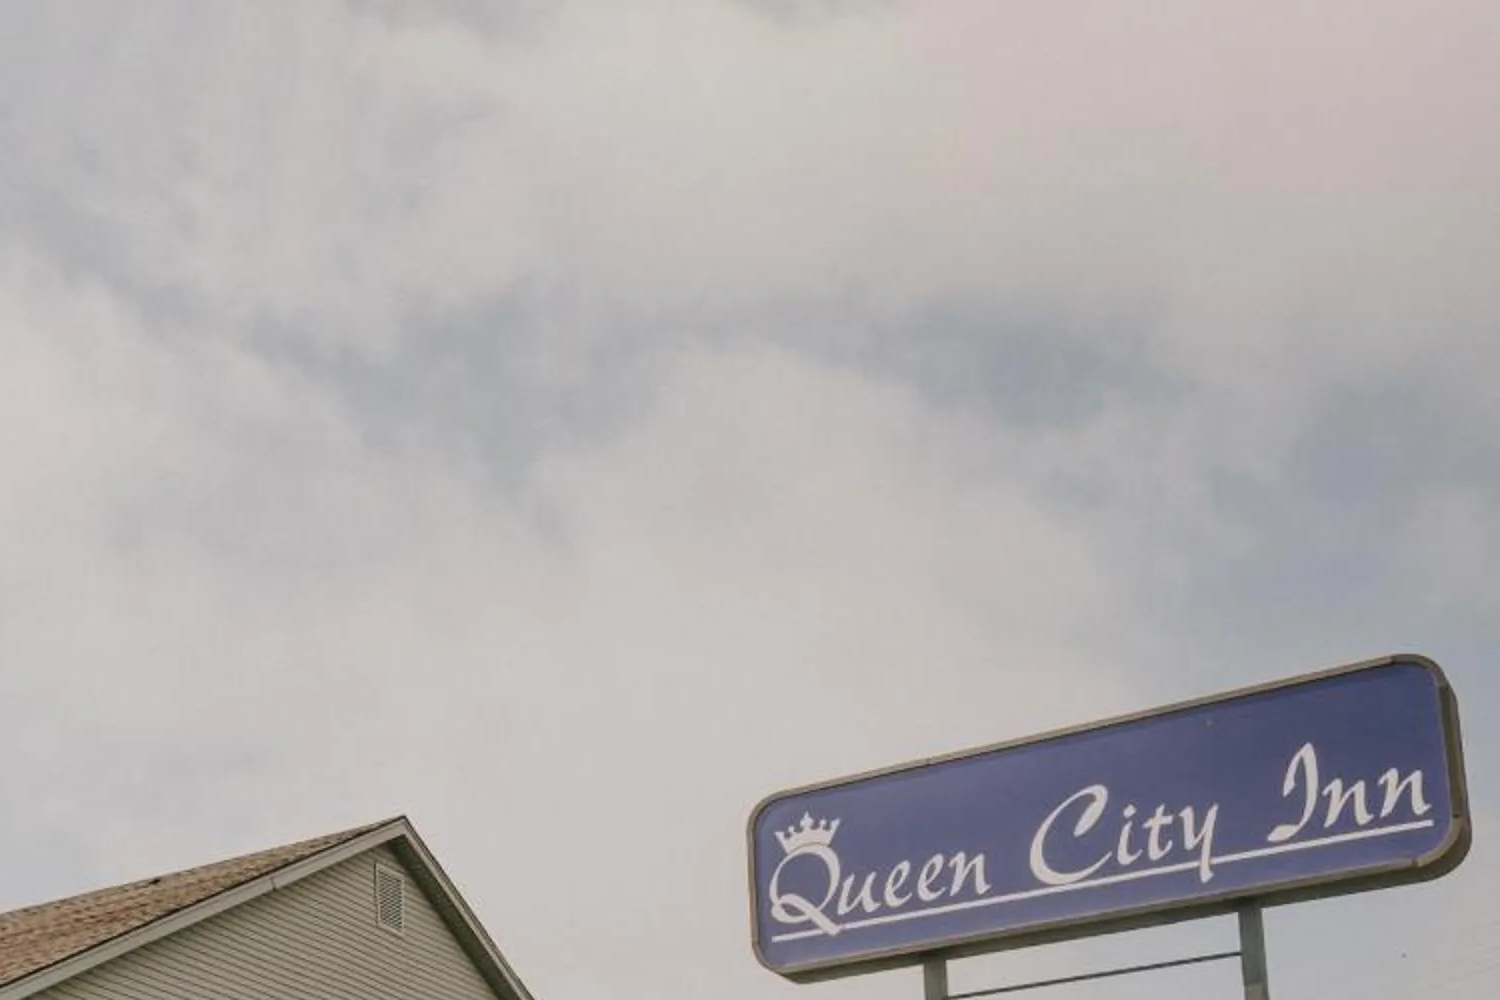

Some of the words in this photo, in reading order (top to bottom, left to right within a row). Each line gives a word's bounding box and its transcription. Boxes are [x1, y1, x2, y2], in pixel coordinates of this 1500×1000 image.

[770, 841, 992, 936] Queen
[1028, 783, 1219, 883] City
[1267, 741, 1433, 844] Inn
